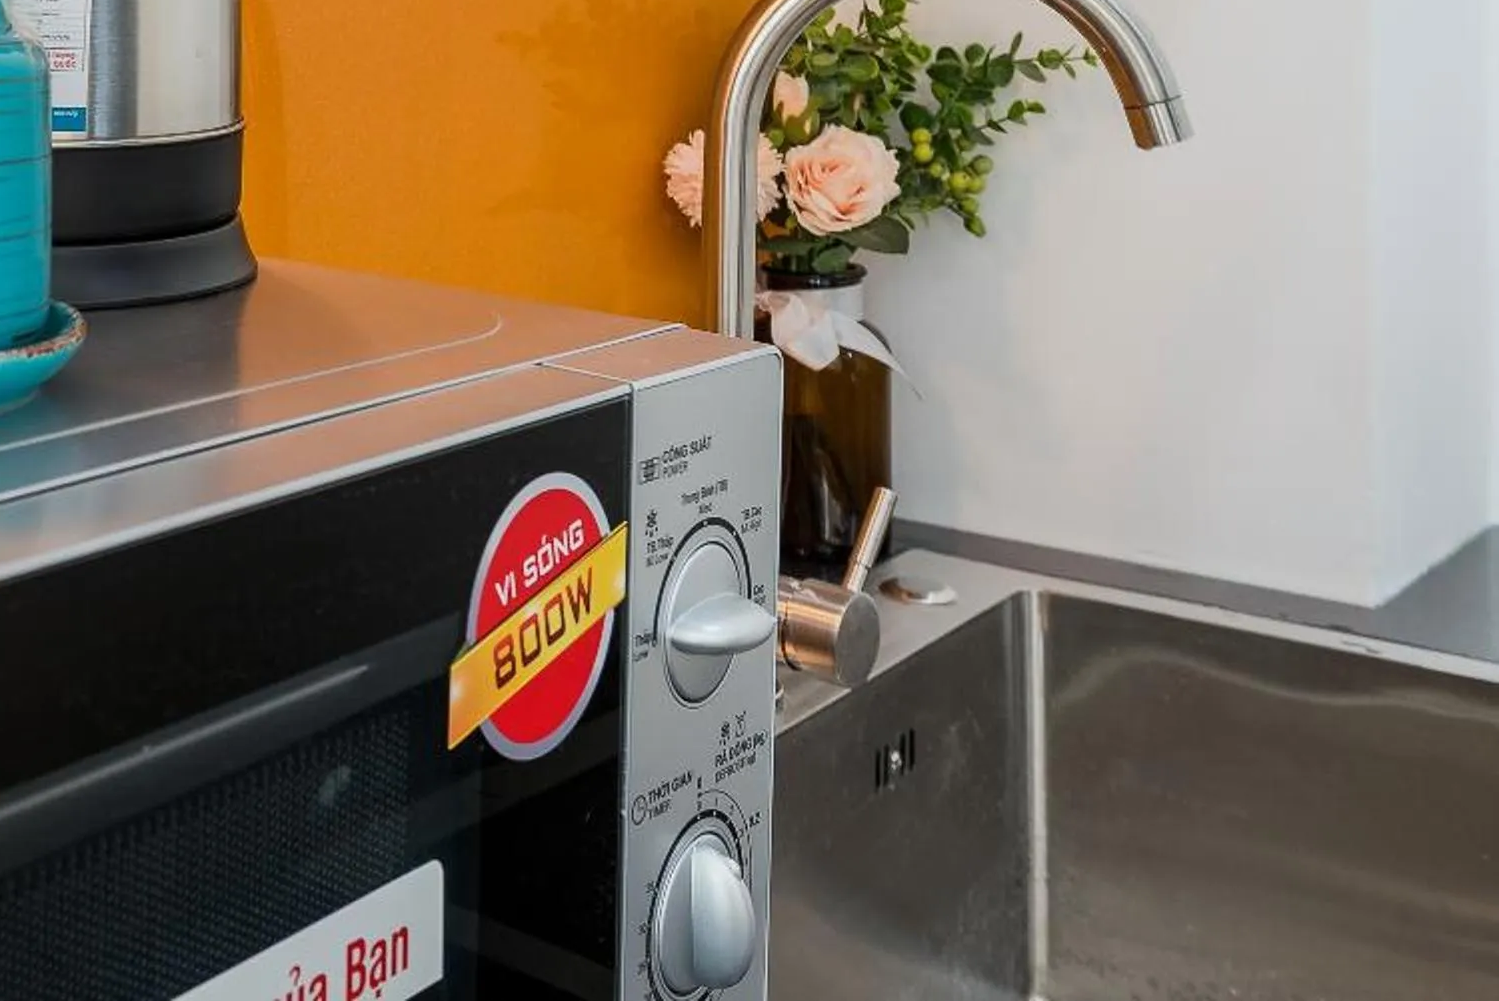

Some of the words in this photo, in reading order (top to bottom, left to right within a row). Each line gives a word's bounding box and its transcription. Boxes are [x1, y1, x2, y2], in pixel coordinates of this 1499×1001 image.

[495, 572, 517, 608] VI
[523, 519, 586, 589] SÓNG
[493, 568, 595, 690] 800W
[273, 964, 327, 1001] ủa
[346, 926, 409, 1001] Bạn
